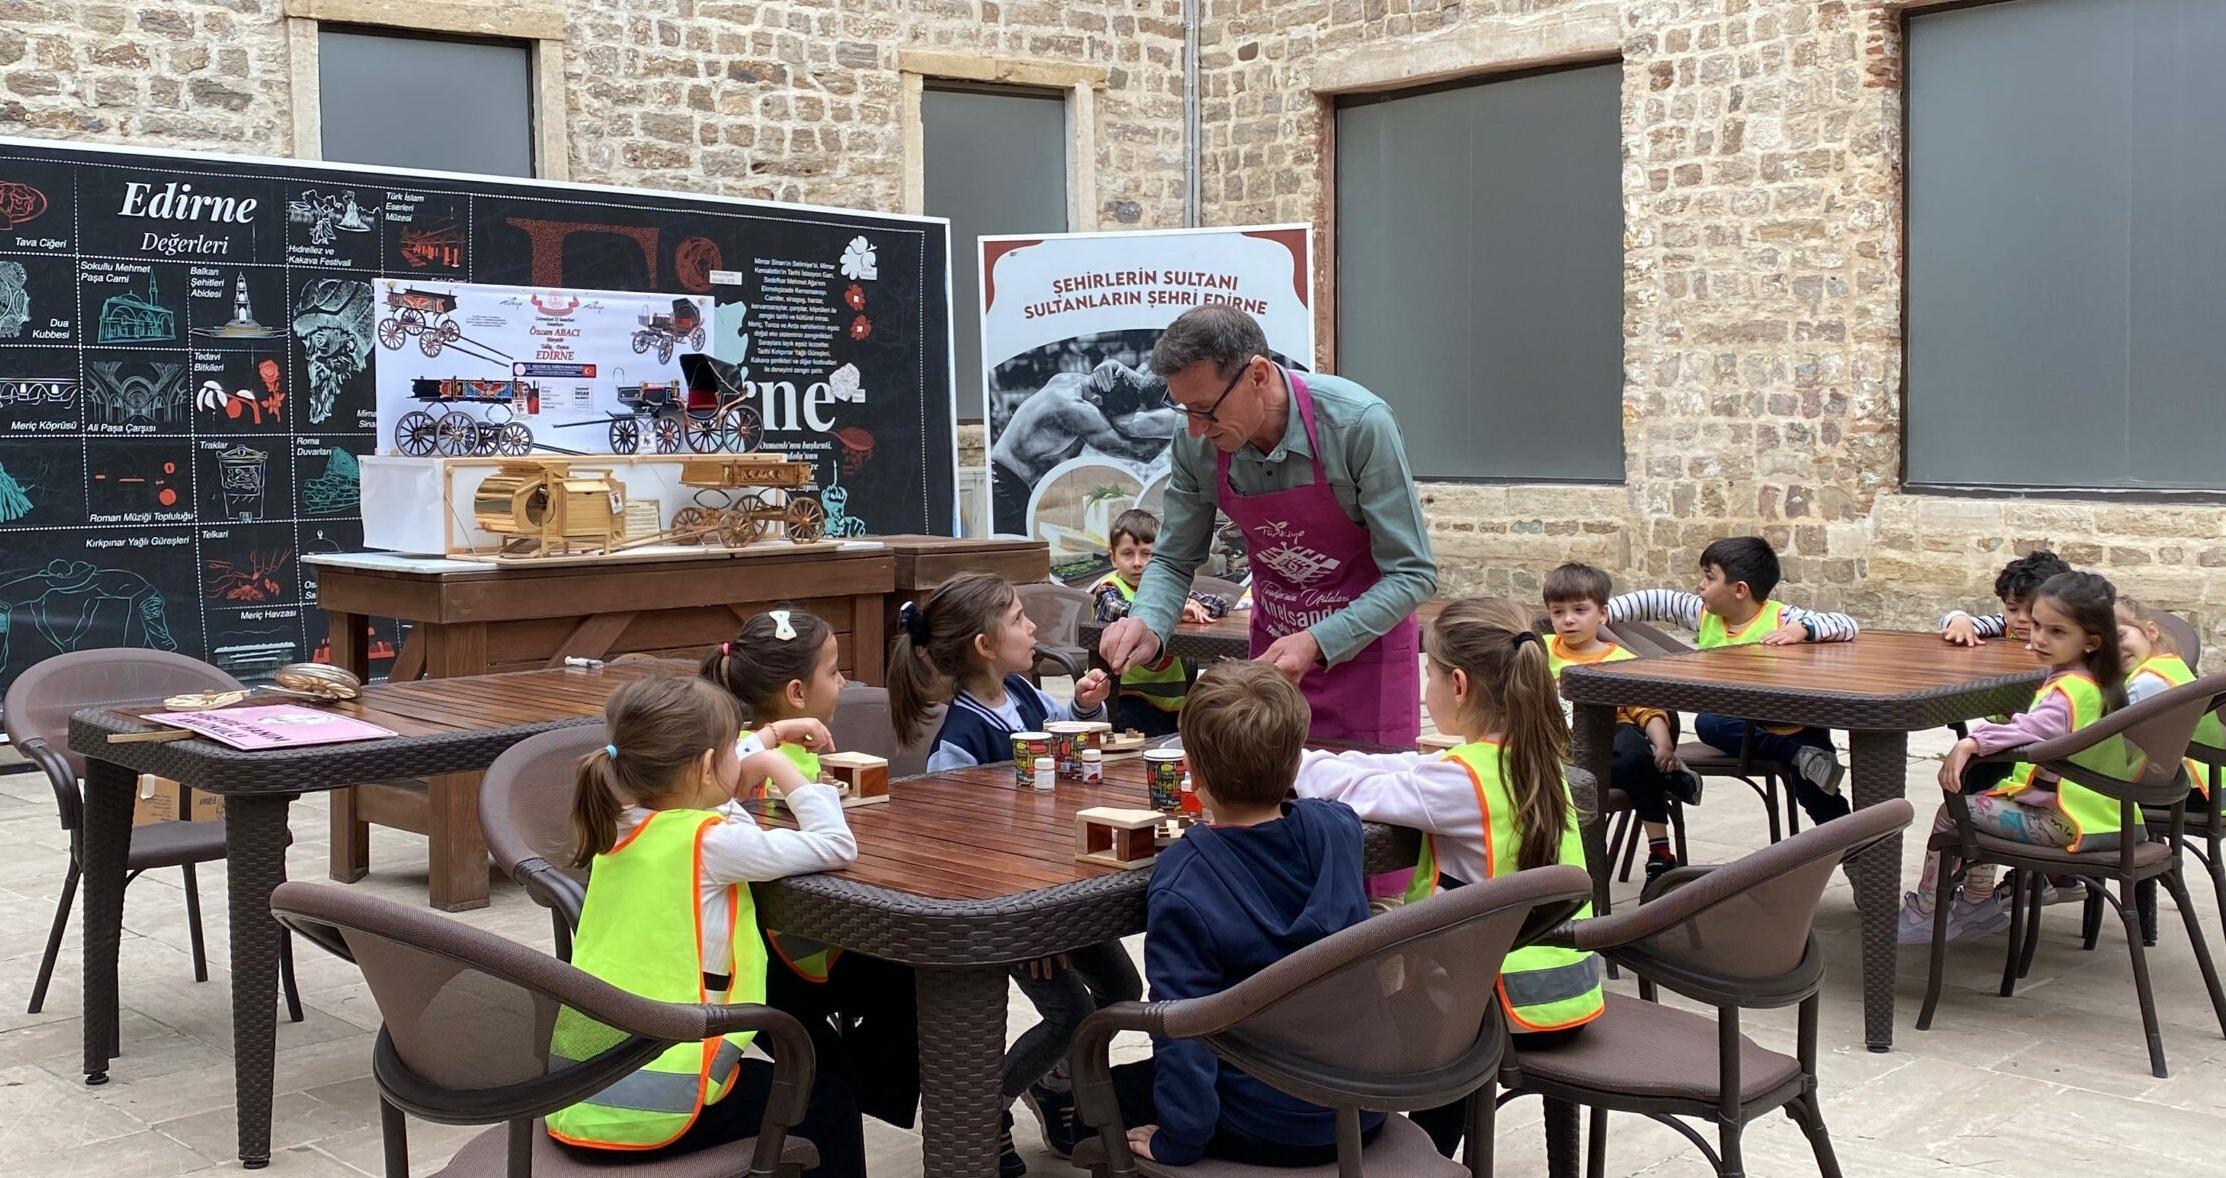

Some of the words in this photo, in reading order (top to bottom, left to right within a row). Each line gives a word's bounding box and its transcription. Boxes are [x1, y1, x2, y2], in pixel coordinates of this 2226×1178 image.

[118, 181, 257, 223] Edirne
[386, 192, 403, 200] Türk
[404, 192, 424, 202] İslam
[386, 202, 414, 212] Eserleri
[386, 213, 412, 222] Müzesi
[16, 237, 37, 246] Tava
[40, 238, 67, 249] Ciğeri
[140, 231, 228, 255] Değerleri
[288, 256, 318, 265] Kakava
[320, 257, 352, 266] Festivali
[80, 261, 113, 272] Sokullu
[115, 263, 151, 273] Mehmet
[190, 266, 219, 276] Balkan
[81, 272, 104, 284] Paşa
[106, 274, 130, 283] Cami
[191, 278, 224, 288] Şehitleri
[1052, 268, 1157, 297] ŞEHİRLERİN
[1163, 270, 1238, 291] SULTANI
[190, 289, 222, 298] Abidesi
[1024, 290, 1142, 320] SULTANLARIN
[1147, 288, 1197, 308] ŞEHRİ
[50, 318, 69, 328] Dua
[32, 330, 70, 339] Kubbesi
[530, 326, 553, 336] Özcan
[554, 328, 581, 337] ABACI
[194, 352, 221, 362] Tedavi
[536, 350, 574, 361] EDİRNE
[194, 362, 224, 372] Bitkileri
[357, 410, 376, 418] Mima
[11, 420, 36, 431] Meriç
[38, 420, 78, 431] Köprüsü
[87, 424, 99, 432] Ali
[101, 424, 124, 434] Paşa
[126, 423, 156, 434] Çarşısı
[358, 420, 376, 428] Sina
[200, 440, 228, 450] Traklar
[296, 438, 320, 446] Roma
[296, 448, 332, 456] Duvarları
[90, 513, 122, 522] Roman
[123, 512, 152, 523] Müziği
[154, 510, 194, 522] Topluluğu
[202, 530, 229, 539] Telkari
[86, 538, 126, 549] Kırkpınar
[127, 536, 150, 548] Yağlı
[151, 535, 190, 546] Güreşleri
[240, 611, 263, 621] Meriç
[264, 609, 297, 618] Havzası
